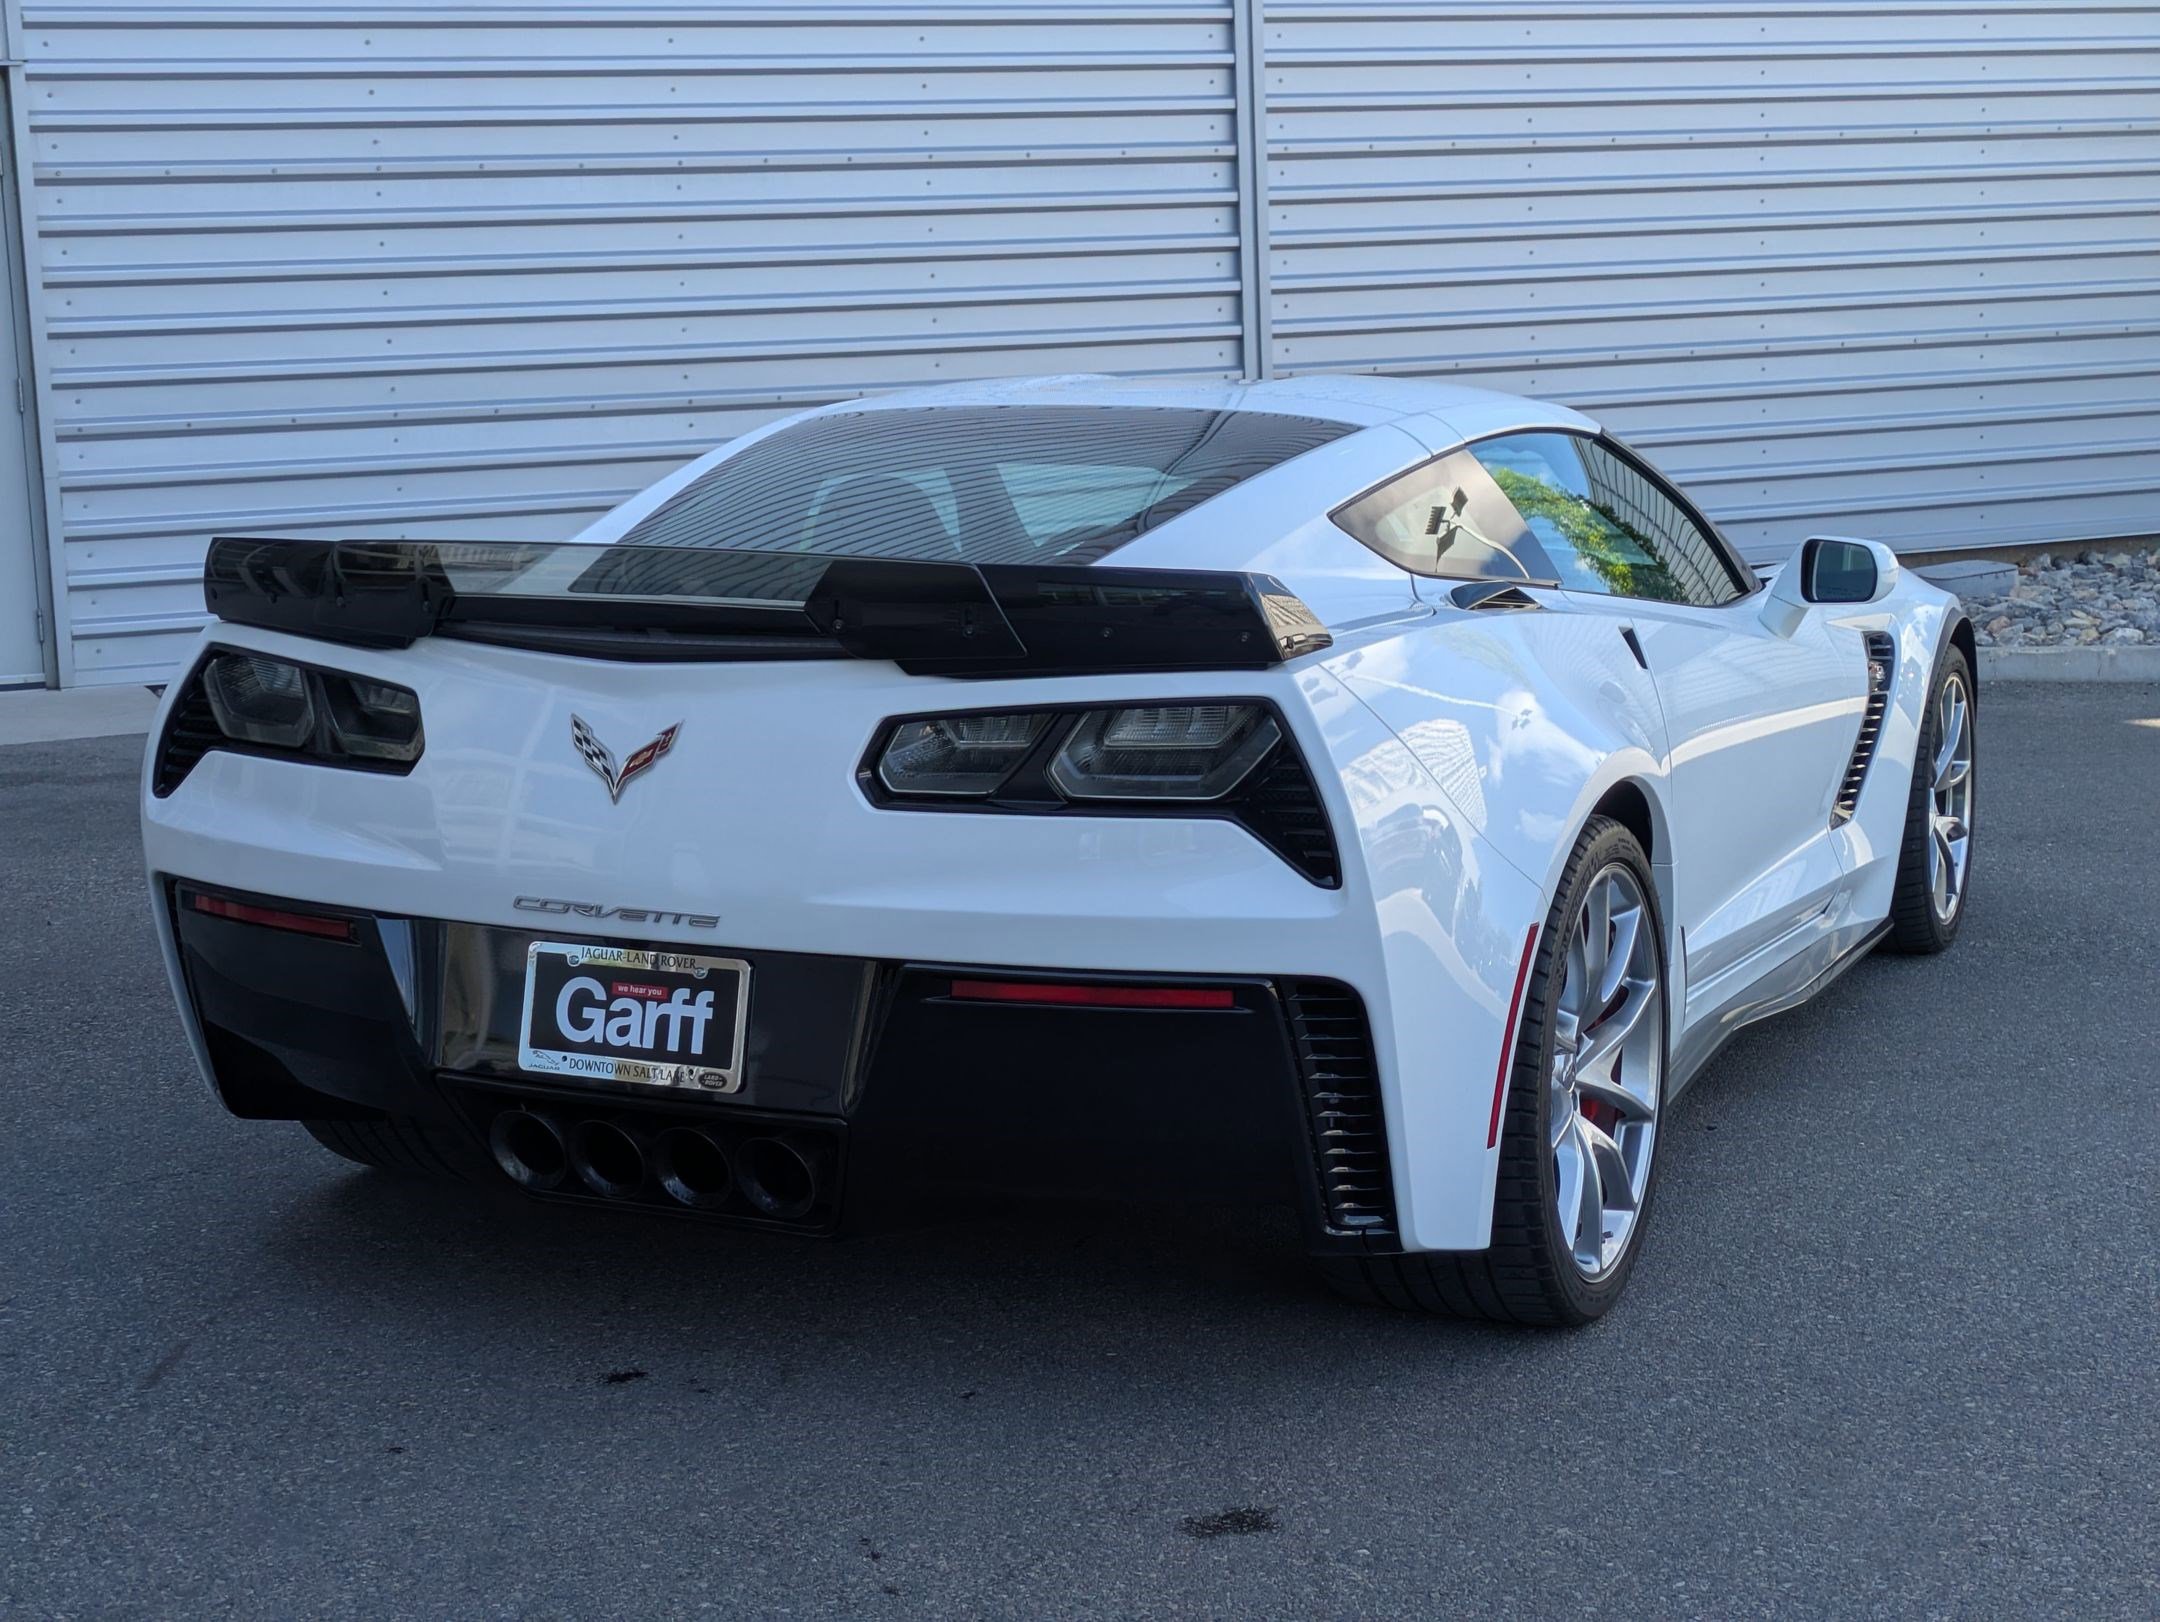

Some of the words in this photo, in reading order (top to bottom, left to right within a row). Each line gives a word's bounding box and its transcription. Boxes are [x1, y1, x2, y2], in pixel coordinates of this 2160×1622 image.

[512, 895, 721, 928] CORVETTE
[660, 954, 696, 969] ROVER
[617, 985, 628, 993] we
[629, 984, 646, 994] hear
[647, 987, 662, 997] you
[556, 976, 715, 1055] Garff
[528, 1063, 561, 1071] JAGUAR
[569, 1058, 630, 1075] DOWNTOWN
[633, 1066, 657, 1079] SALT
